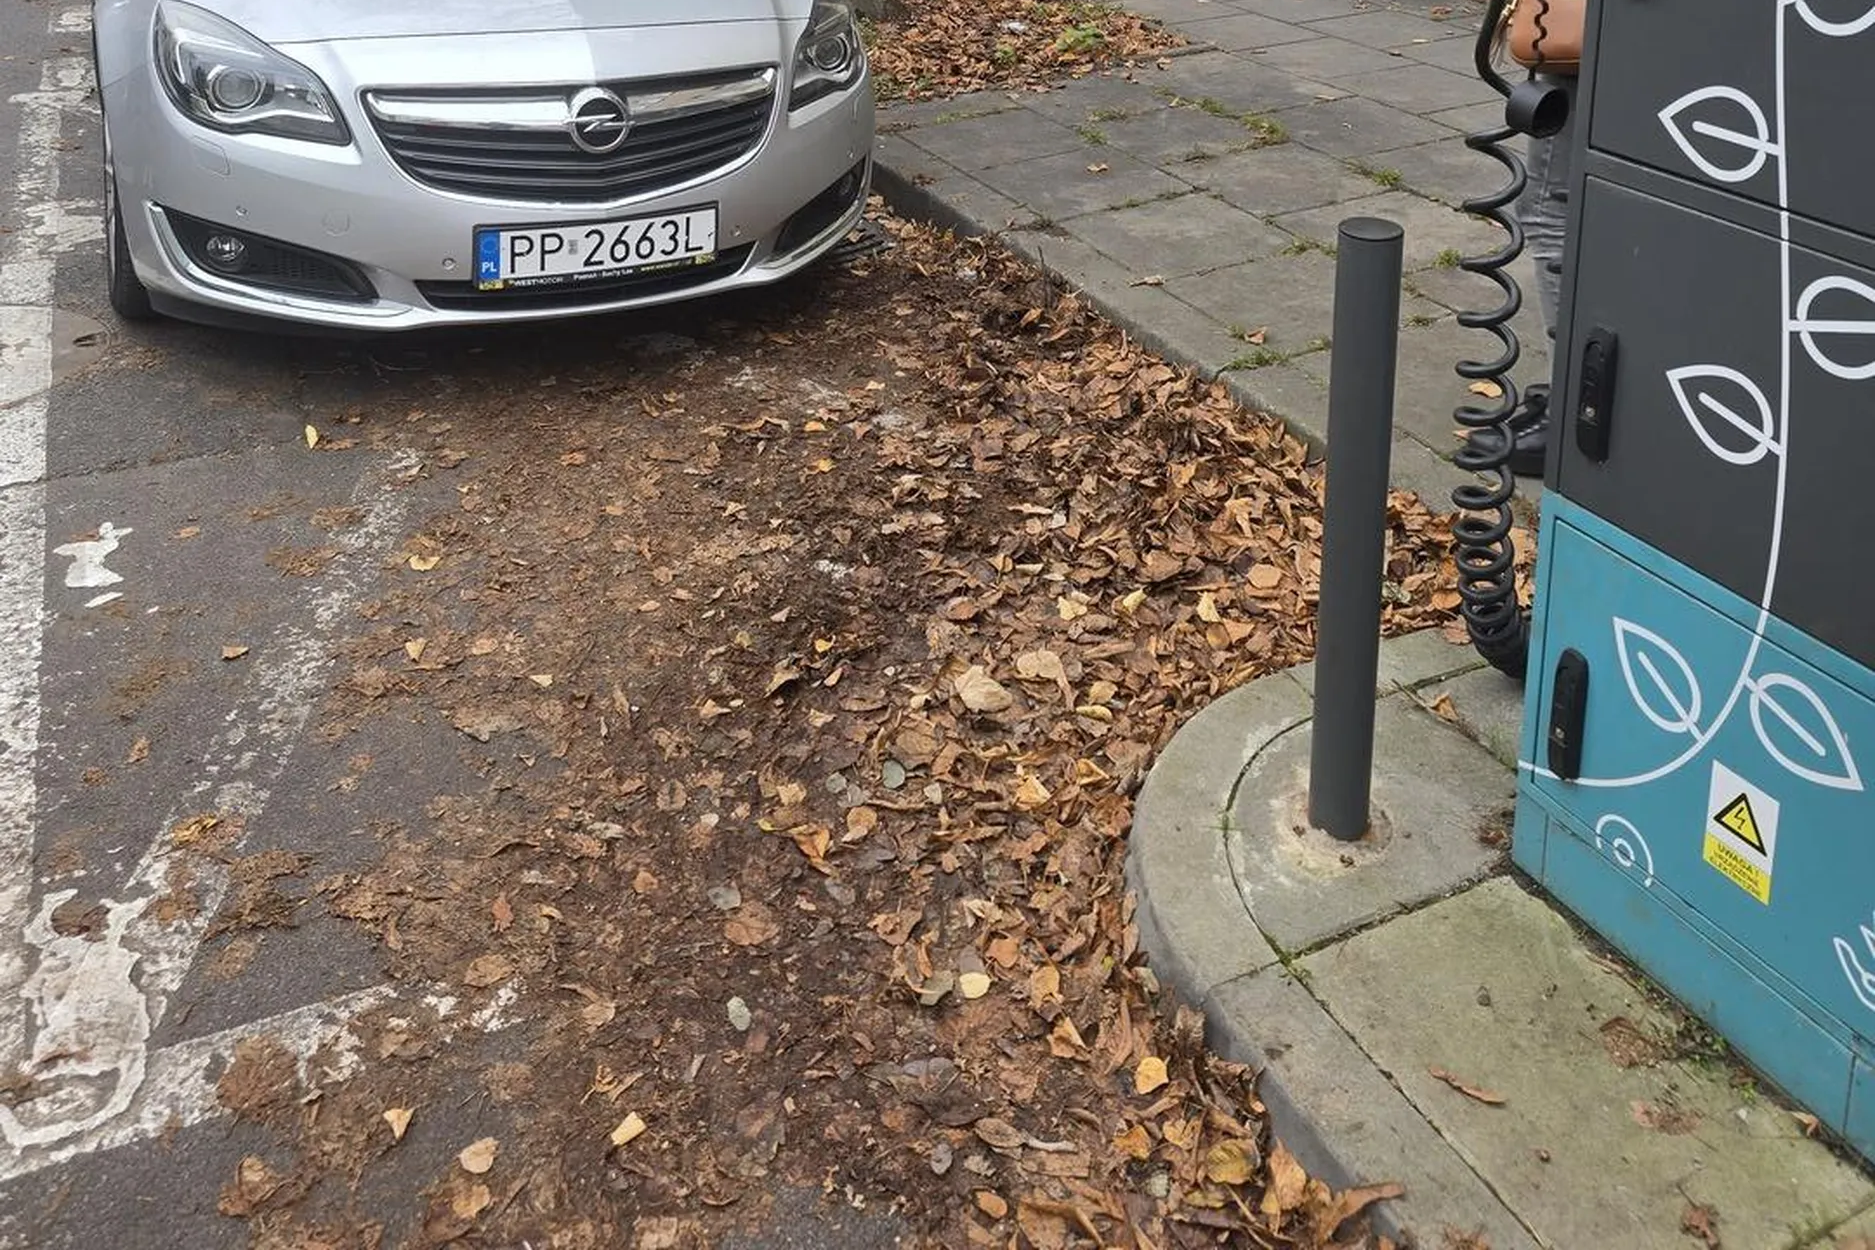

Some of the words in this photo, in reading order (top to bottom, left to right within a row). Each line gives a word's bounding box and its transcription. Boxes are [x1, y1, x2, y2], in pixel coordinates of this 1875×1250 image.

[510, 232, 564, 274] PP
[583, 216, 704, 267] 2663L
[482, 261, 497, 273] PL
